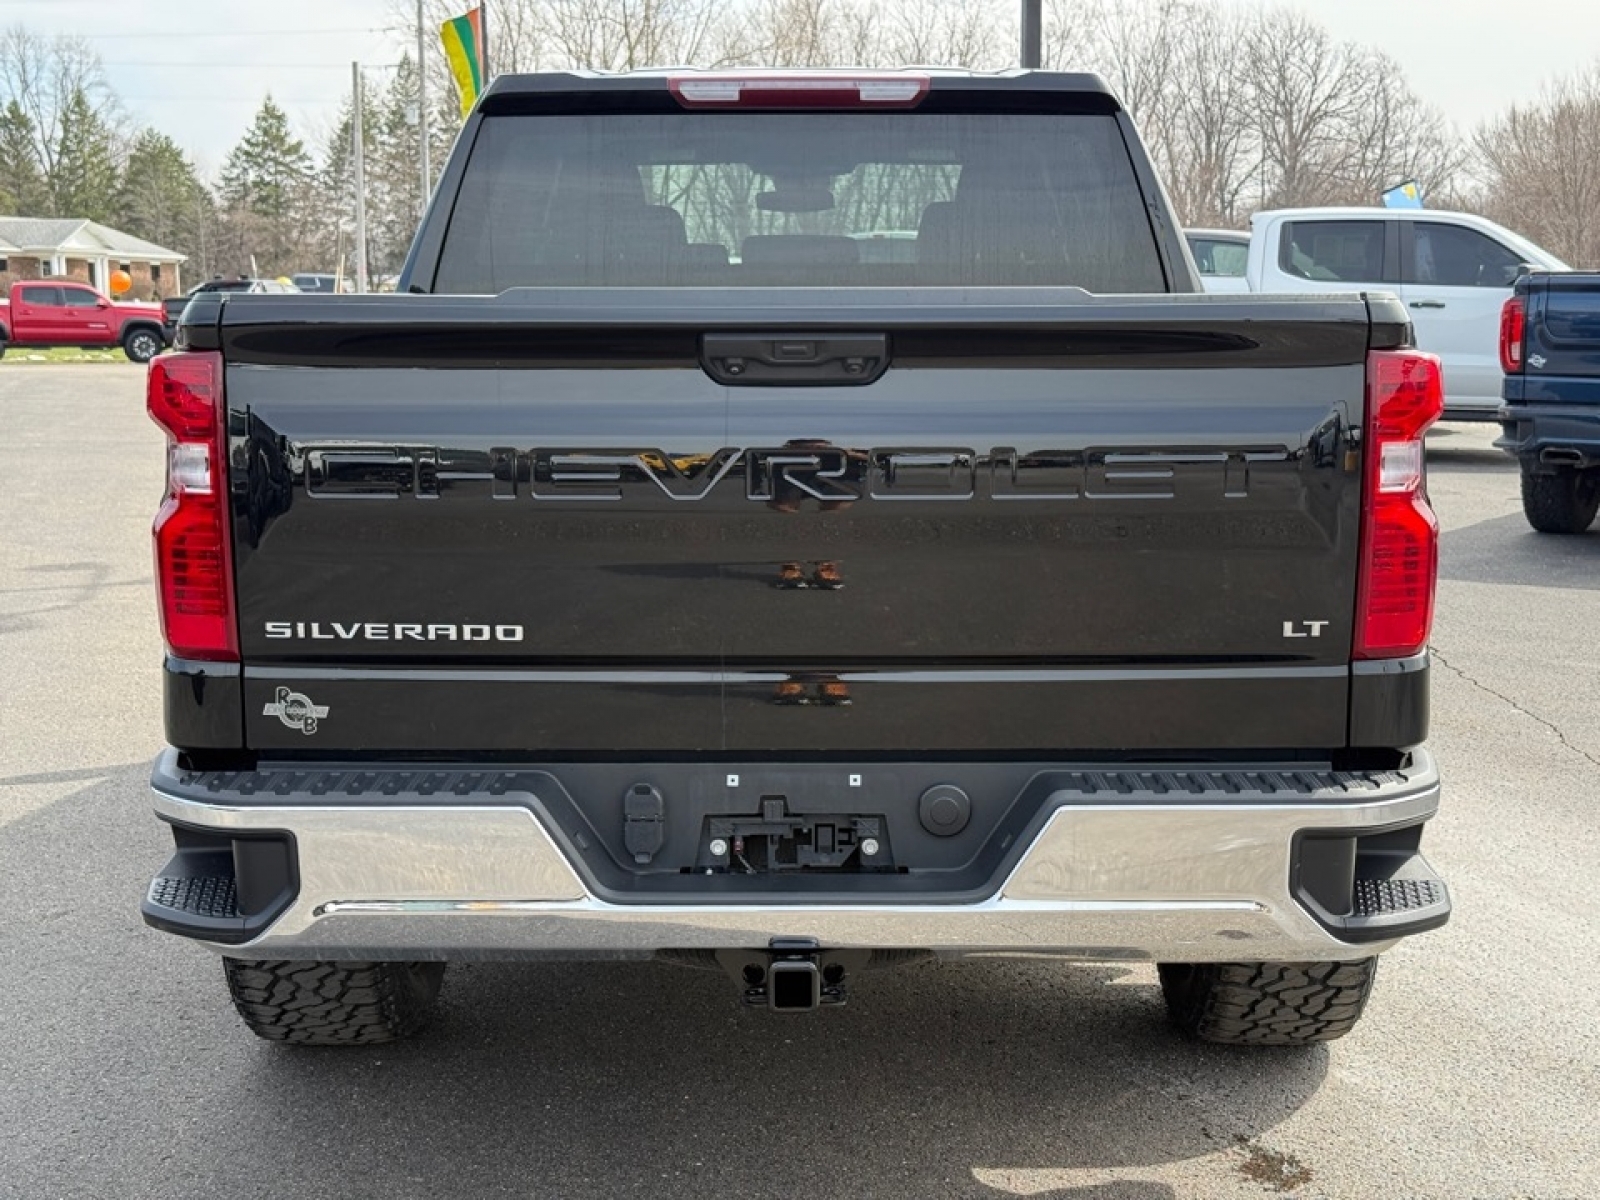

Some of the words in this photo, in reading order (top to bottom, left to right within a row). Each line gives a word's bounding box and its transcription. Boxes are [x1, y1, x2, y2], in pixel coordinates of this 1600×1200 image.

[304, 445, 1290, 501] CHEVROLET
[264, 621, 524, 642] SILVERADO
[1282, 619, 1329, 638] LT
